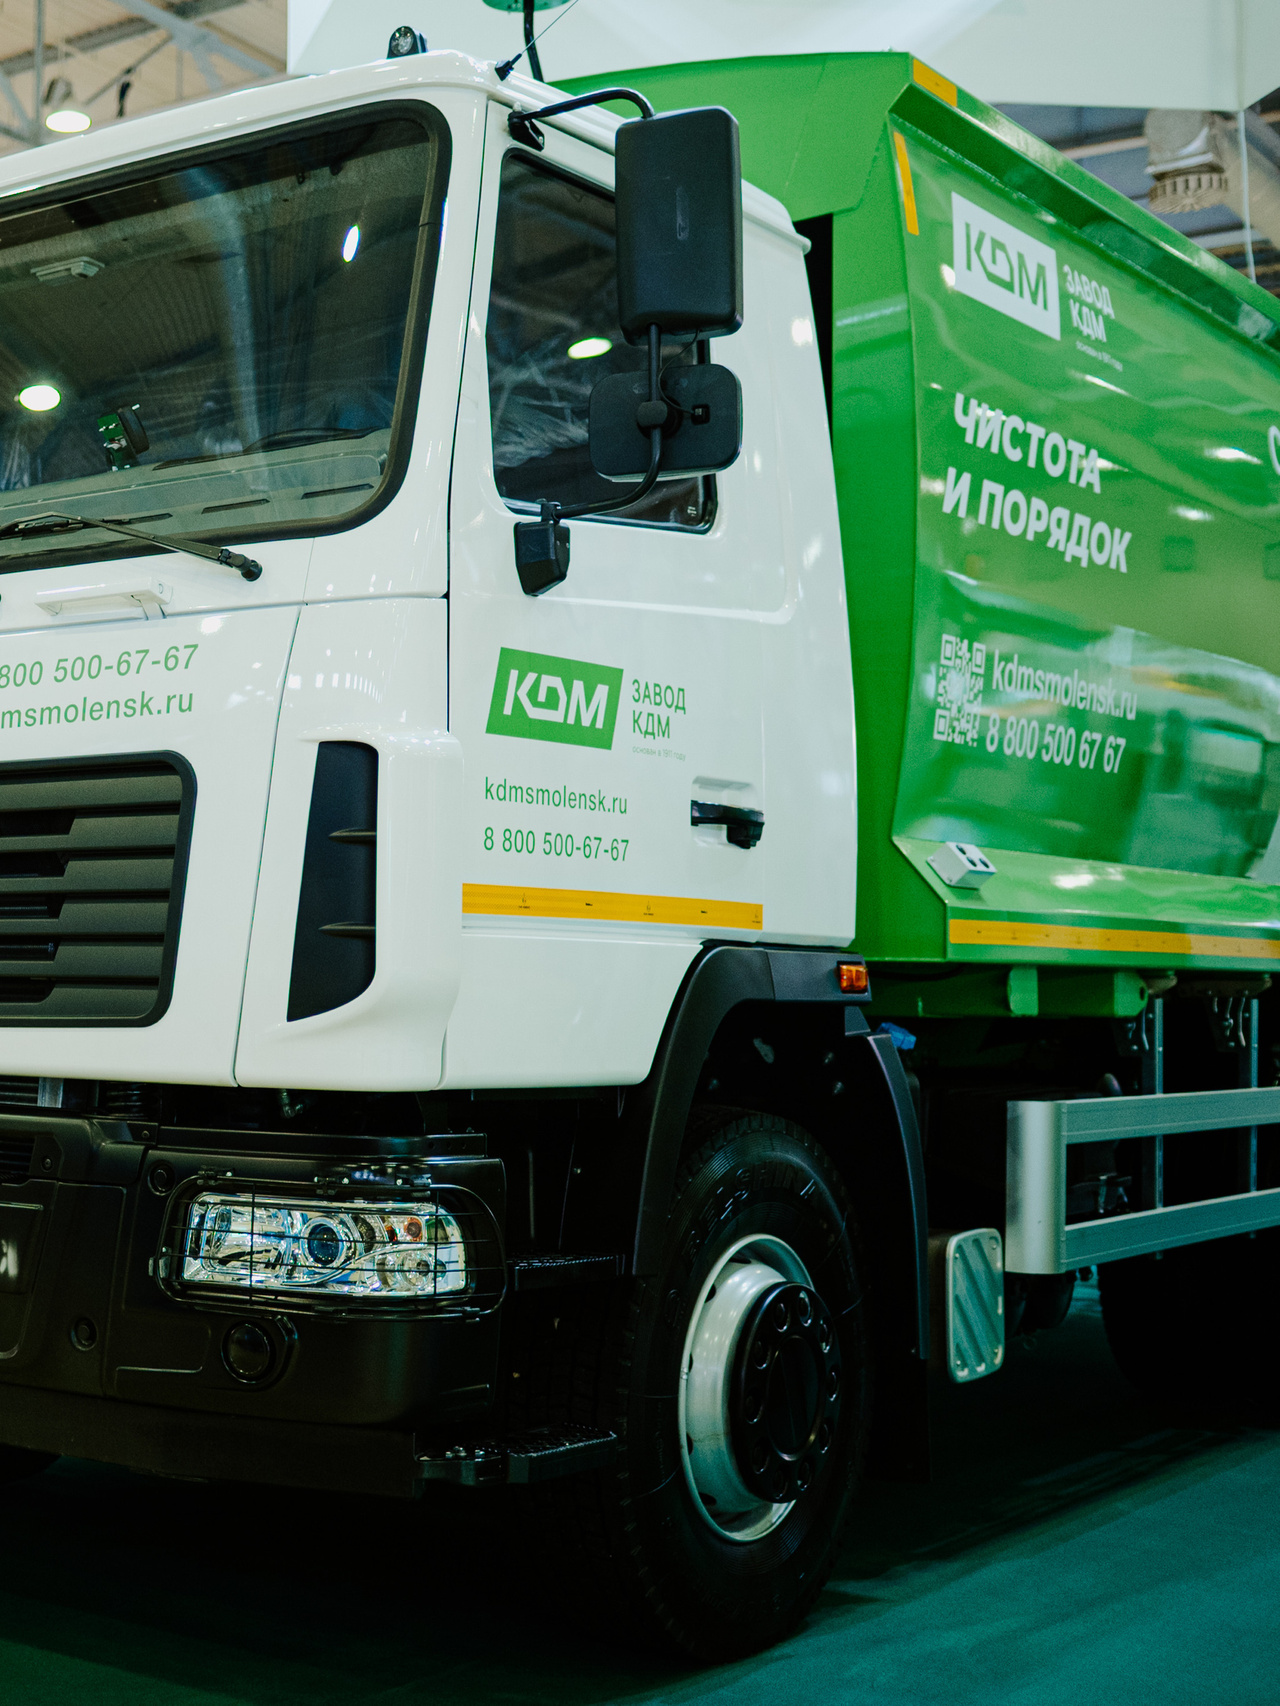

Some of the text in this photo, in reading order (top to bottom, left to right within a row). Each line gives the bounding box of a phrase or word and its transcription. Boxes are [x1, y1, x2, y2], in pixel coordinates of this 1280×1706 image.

[1063, 264, 1116, 319] ЗАВОД
[1070, 299, 1107, 342] КДМ
[953, 391, 1102, 494] ЧИСТОТА
[941, 466, 1133, 574] И ПОРЯДОК
[53, 643, 199, 683] 500-67-67
[631, 679, 687, 715] ЗАВОД
[992, 649, 1138, 721] kdmsmolensk.ru
[632, 709, 670, 740] КДМ
[985, 712, 1127, 774] 8 800 500 67 67
[485, 776, 628, 815] kdmsmolensk.ru
[483, 826, 630, 862] 8 800 500-67-67
